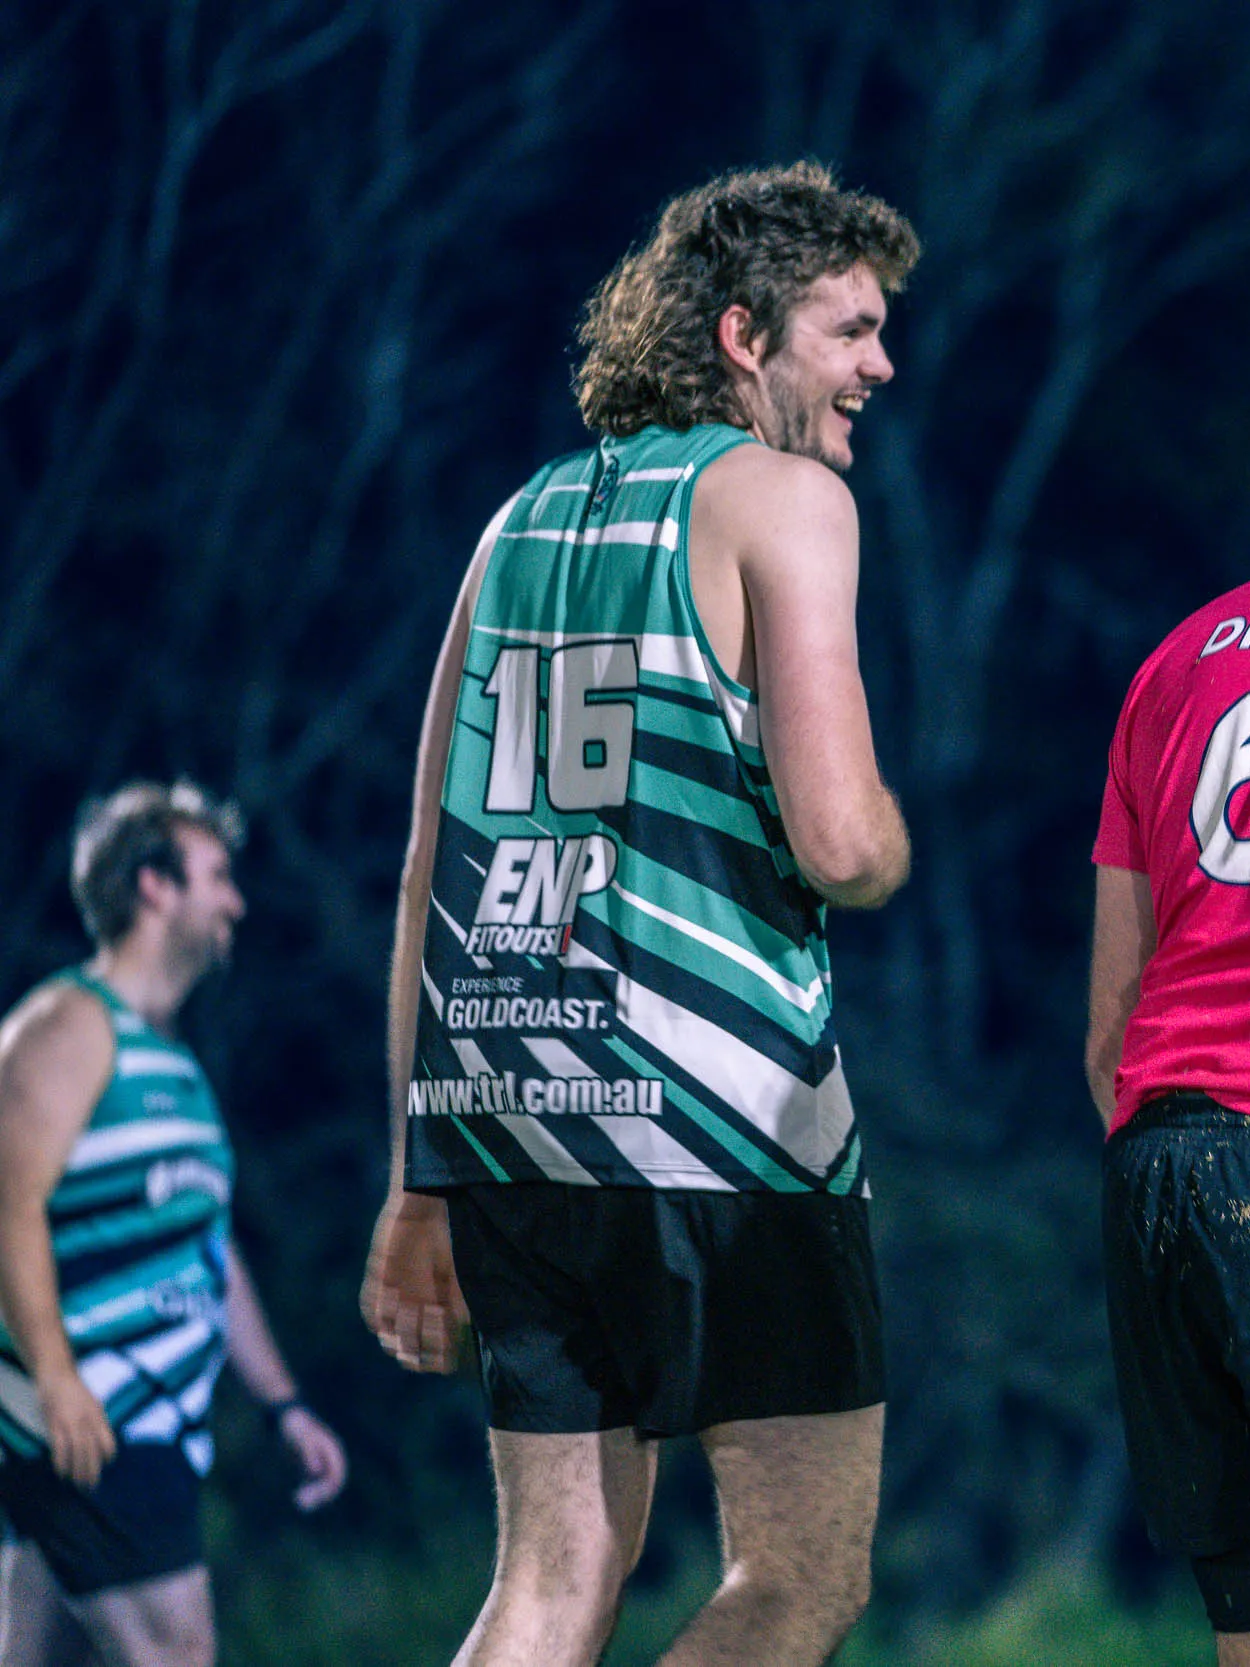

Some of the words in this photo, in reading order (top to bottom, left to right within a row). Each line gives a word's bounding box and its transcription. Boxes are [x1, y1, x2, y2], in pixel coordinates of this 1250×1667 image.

[483, 638, 639, 813] 16
[473, 834, 617, 926] ENP
[464, 924, 562, 955] FITOUTS
